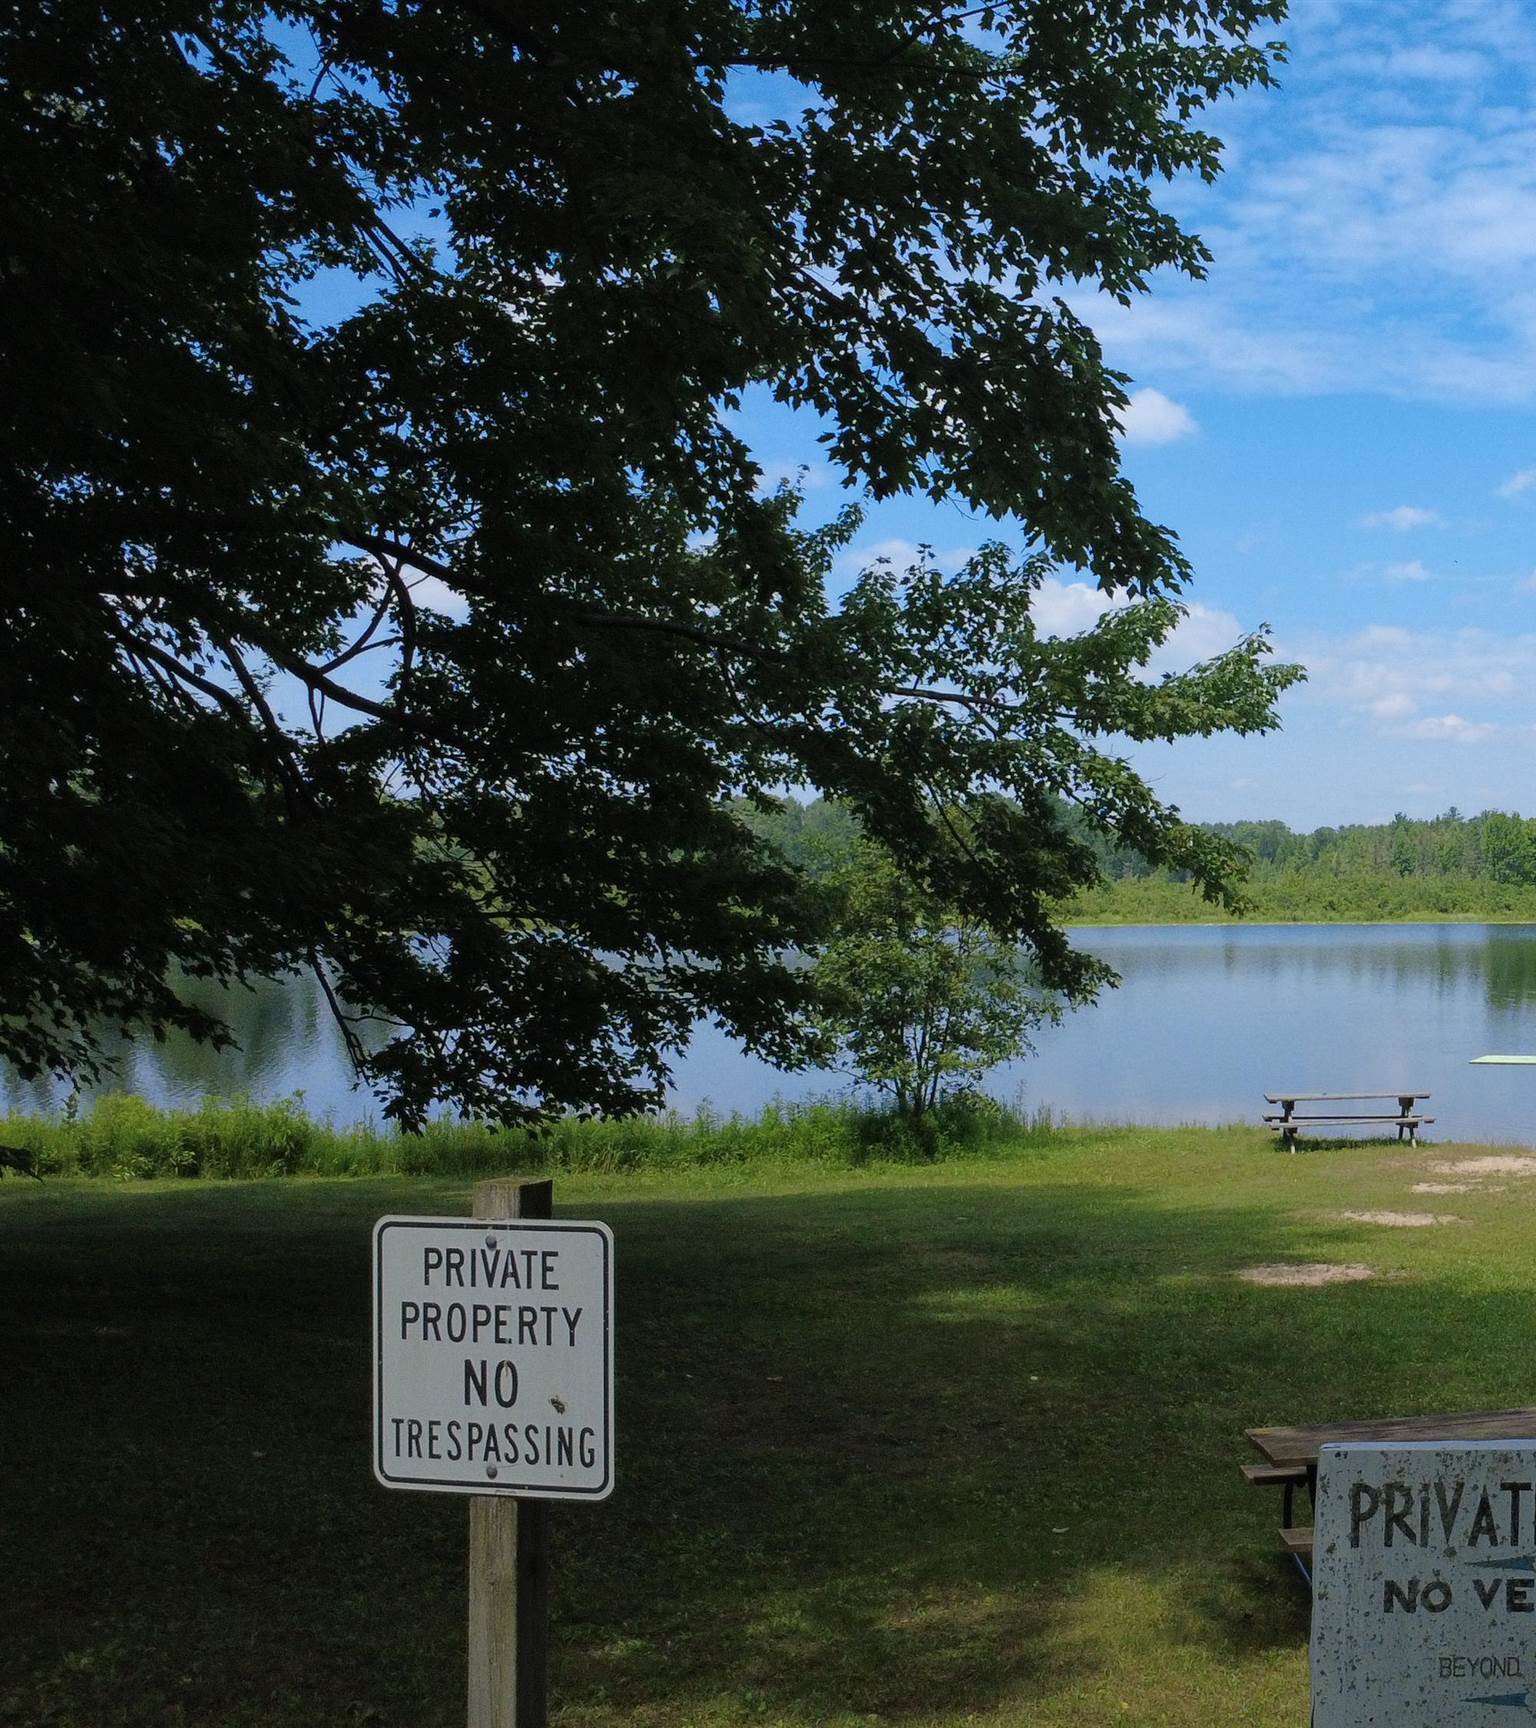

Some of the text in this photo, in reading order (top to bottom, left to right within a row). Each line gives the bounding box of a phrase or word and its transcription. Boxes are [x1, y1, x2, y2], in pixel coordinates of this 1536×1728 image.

[424, 1247, 559, 1290] PRIVATE
[401, 1301, 583, 1347] PROPERTY
[463, 1359, 518, 1408] NO
[391, 1418, 596, 1468] TRESPASSING
[1383, 1578, 1453, 1614] NO
[1438, 1655, 1521, 1679] BEYOND
